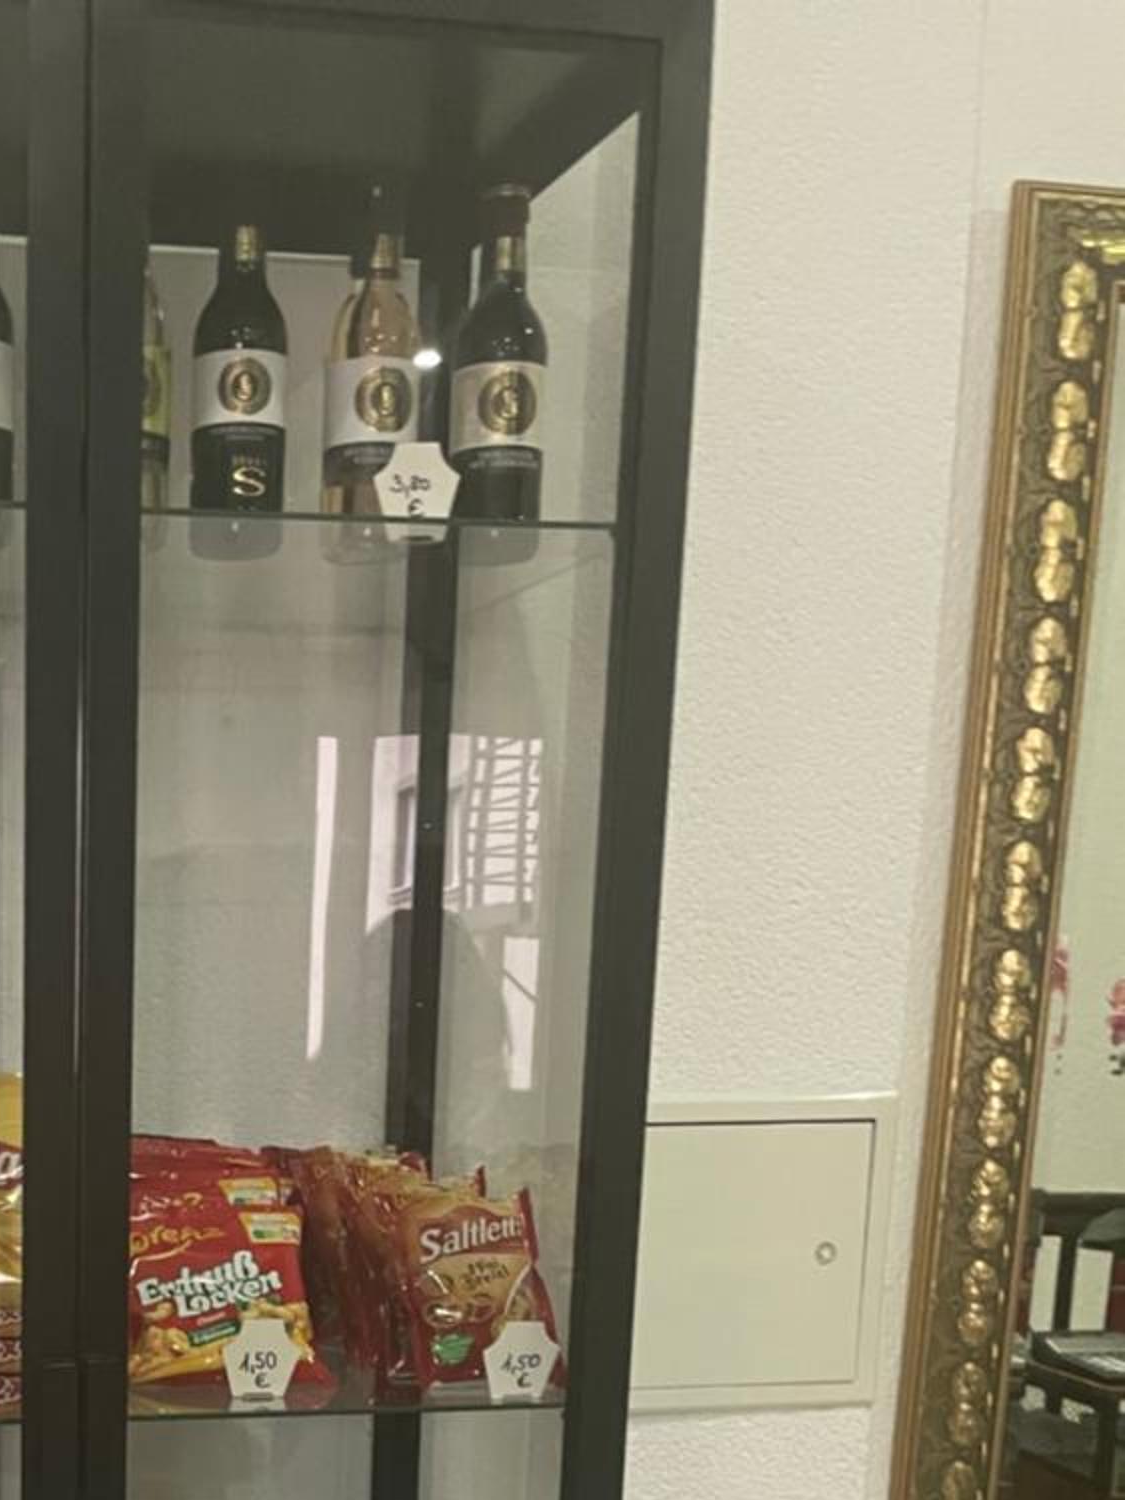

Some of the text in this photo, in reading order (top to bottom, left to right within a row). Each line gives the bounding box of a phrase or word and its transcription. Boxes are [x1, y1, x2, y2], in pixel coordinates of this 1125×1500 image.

[230, 466, 267, 497] S
[389, 473, 431, 498] 3,80
[238, 1350, 278, 1375] 1,50
[500, 1353, 542, 1376] 1,50
[254, 1371, 272, 1389] €
